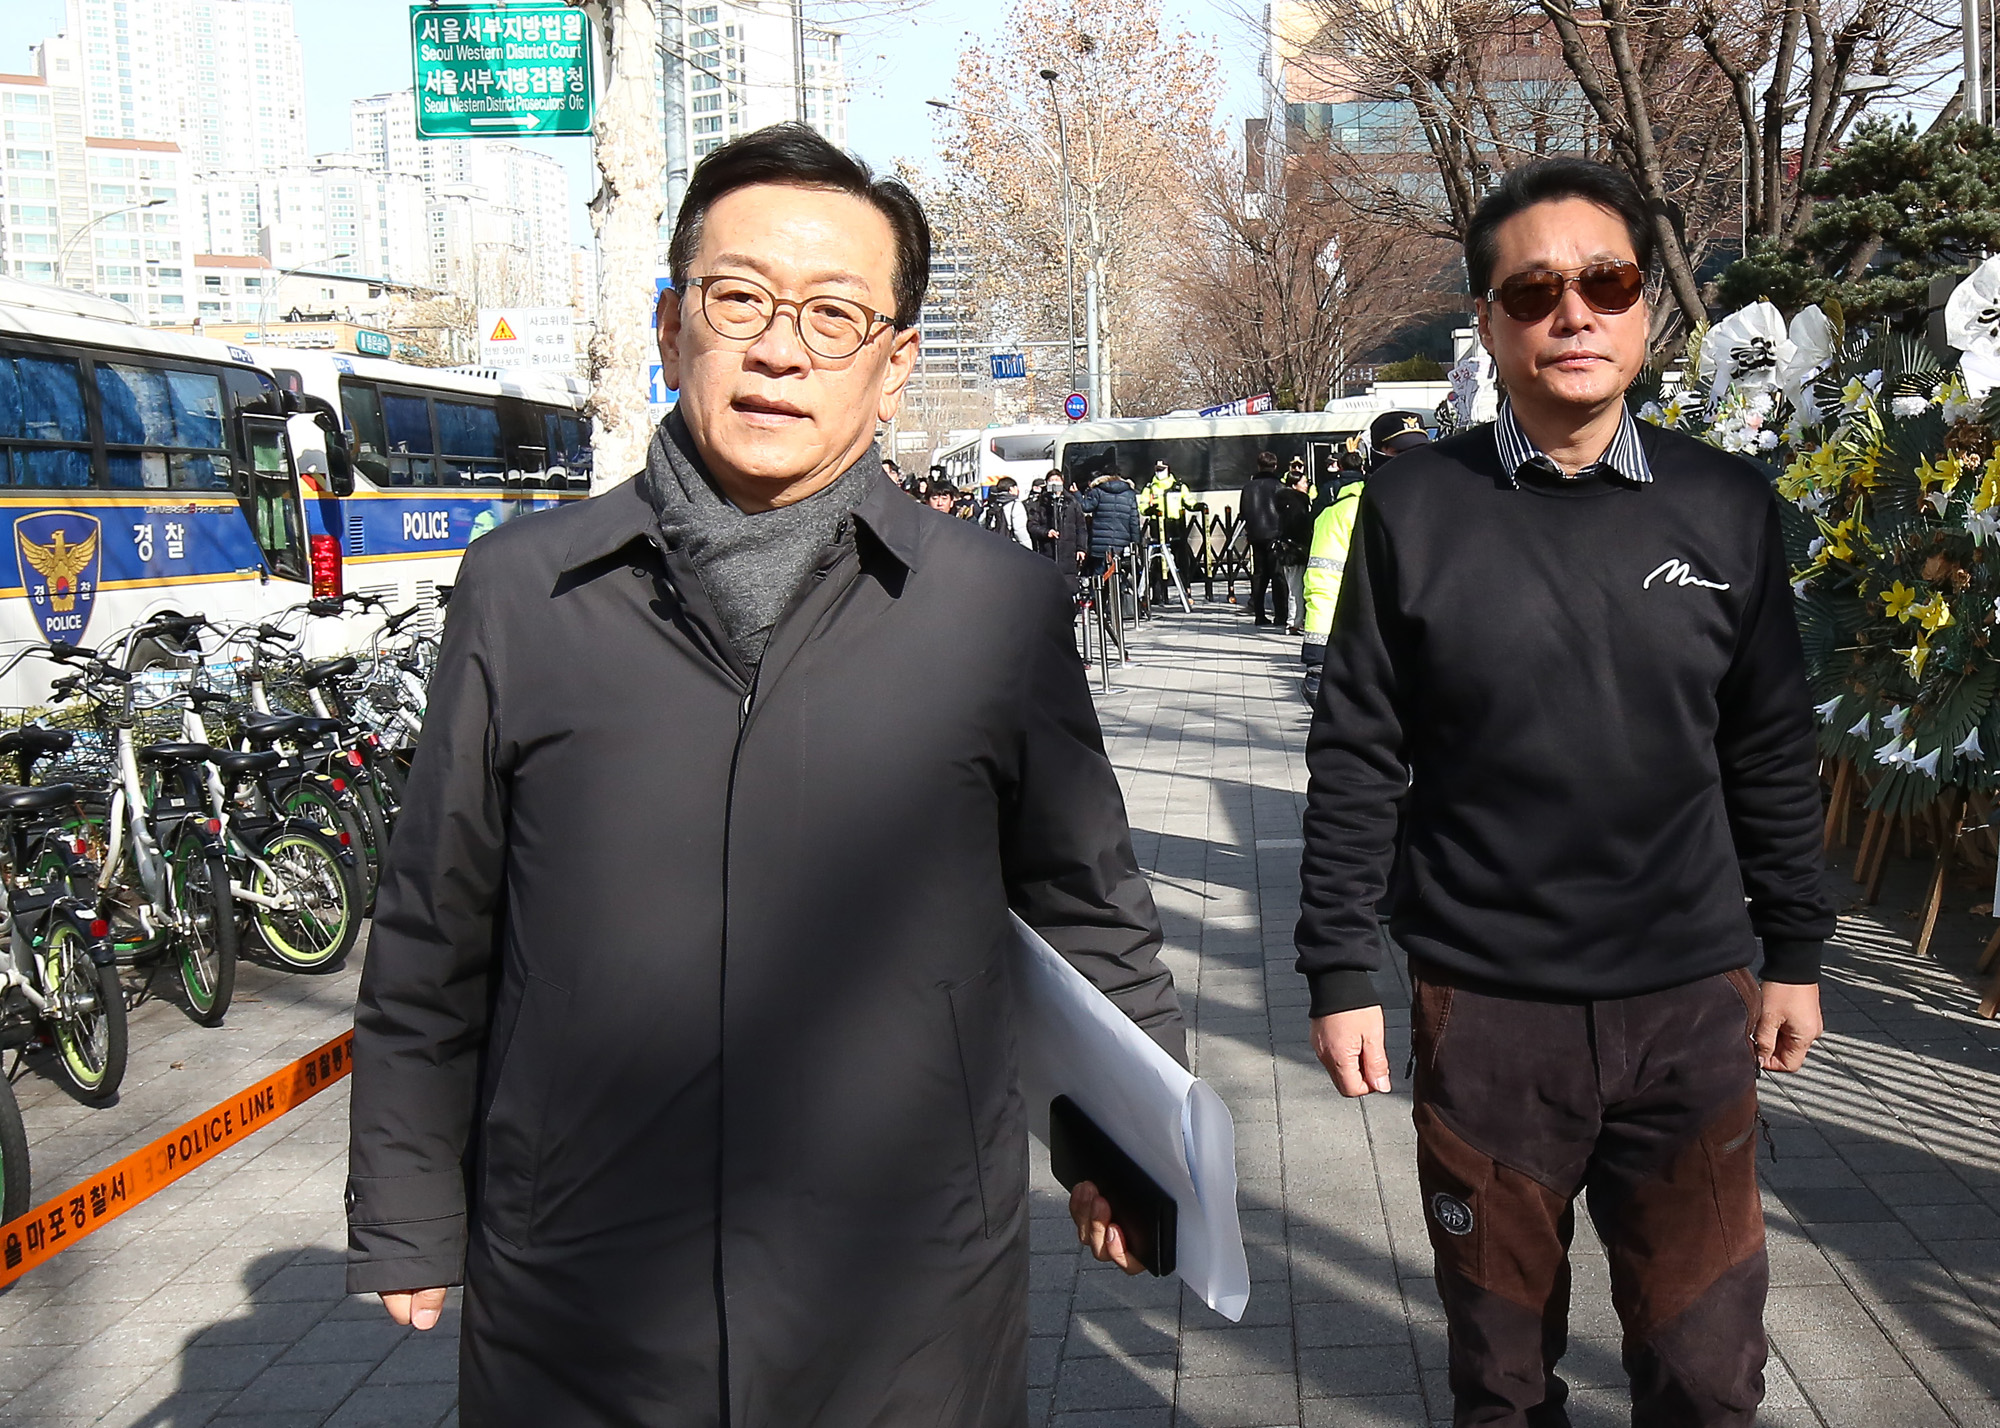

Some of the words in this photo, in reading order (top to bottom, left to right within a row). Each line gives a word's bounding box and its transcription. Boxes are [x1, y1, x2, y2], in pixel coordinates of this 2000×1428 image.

[421, 44, 453, 61] Seoul
[456, 45, 503, 60] Western
[506, 43, 548, 59] District
[550, 42, 582, 59] Court
[425, 96, 449, 113] Seoul
[450, 98, 486, 113] Western
[486, 97, 515, 112] District
[568, 95, 585, 111] Ofc
[529, 316, 569, 326] 사고위험
[535, 334, 565, 344] 속도를
[502, 346, 525, 355] 90m
[531, 353, 571, 365] 줄이시오
[403, 511, 449, 540] POLICE
[46, 614, 82, 632] POLICE
[166, 1109, 233, 1170] POLICE
[240, 1085, 275, 1127] LINE
